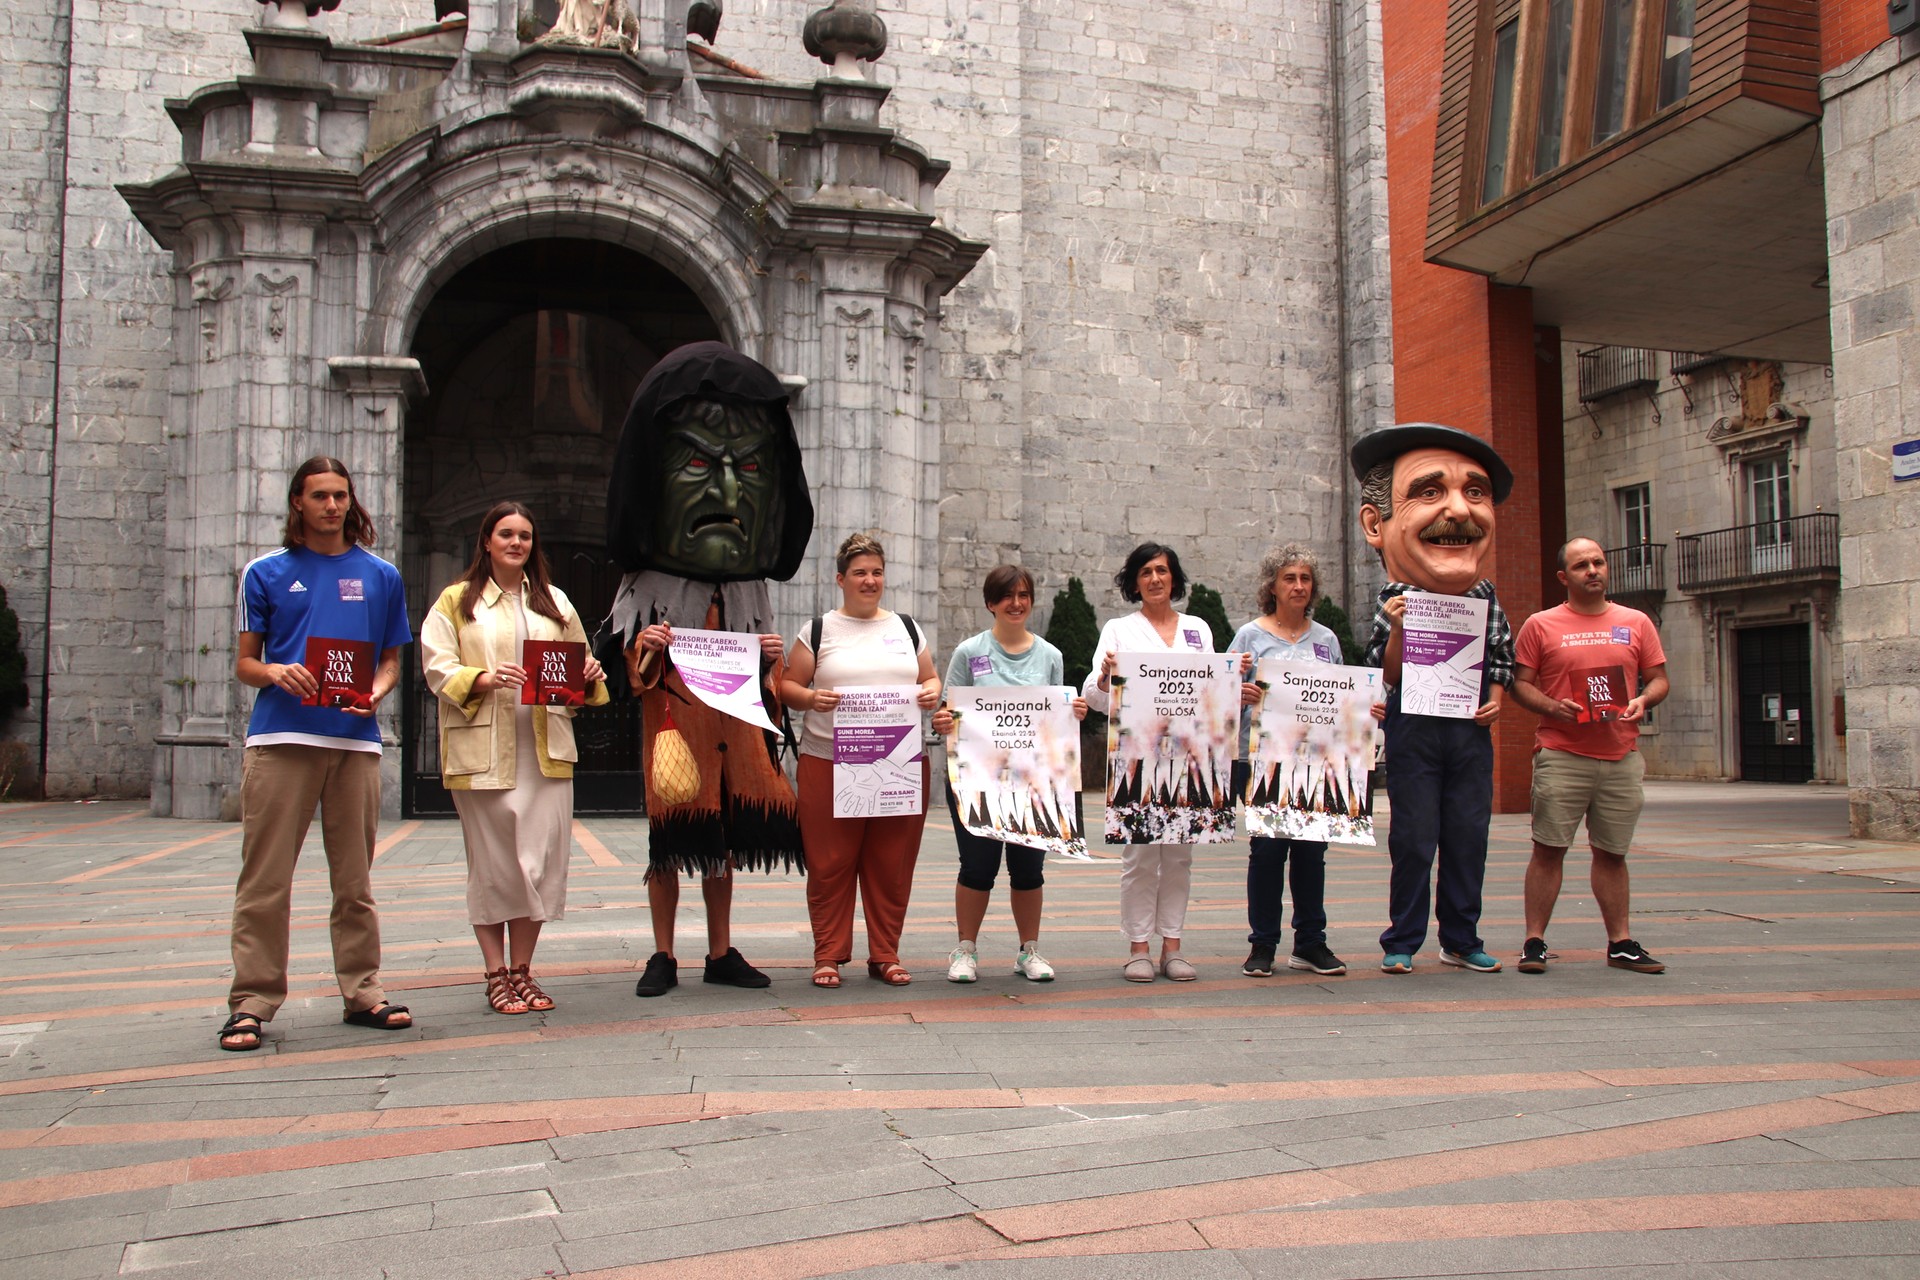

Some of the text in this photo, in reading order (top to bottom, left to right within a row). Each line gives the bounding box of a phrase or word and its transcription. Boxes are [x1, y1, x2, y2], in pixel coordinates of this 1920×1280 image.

[1439, 601, 1465, 609] GABEKO
[1445, 608, 1475, 616] JARRERA
[1562, 632, 1593, 640] NEVER
[694, 643, 714, 651] ALDE,
[710, 638, 738, 646] GABEKO
[1406, 646, 1423, 654] 17-24
[327, 650, 354, 661] SAN
[542, 651, 567, 661] SAN
[327, 661, 352, 672] JOA
[543, 661, 566, 672] JOA
[324, 671, 354, 683] NAK
[541, 671, 568, 682] NAK
[1139, 664, 1214, 681] Sanjoanak
[1283, 671, 1355, 690] Sanjoanak
[1587, 675, 1608, 685] SAN
[1159, 681, 1194, 695] 2023
[1590, 684, 1609, 693] JOA
[1301, 690, 1335, 705] 2023
[1589, 692, 1613, 702] NAK
[975, 697, 1052, 714] Sanjoanak
[1295, 704, 1320, 712] Ekainak
[995, 715, 1031, 728] 2023
[838, 745, 859, 753] 17-24
